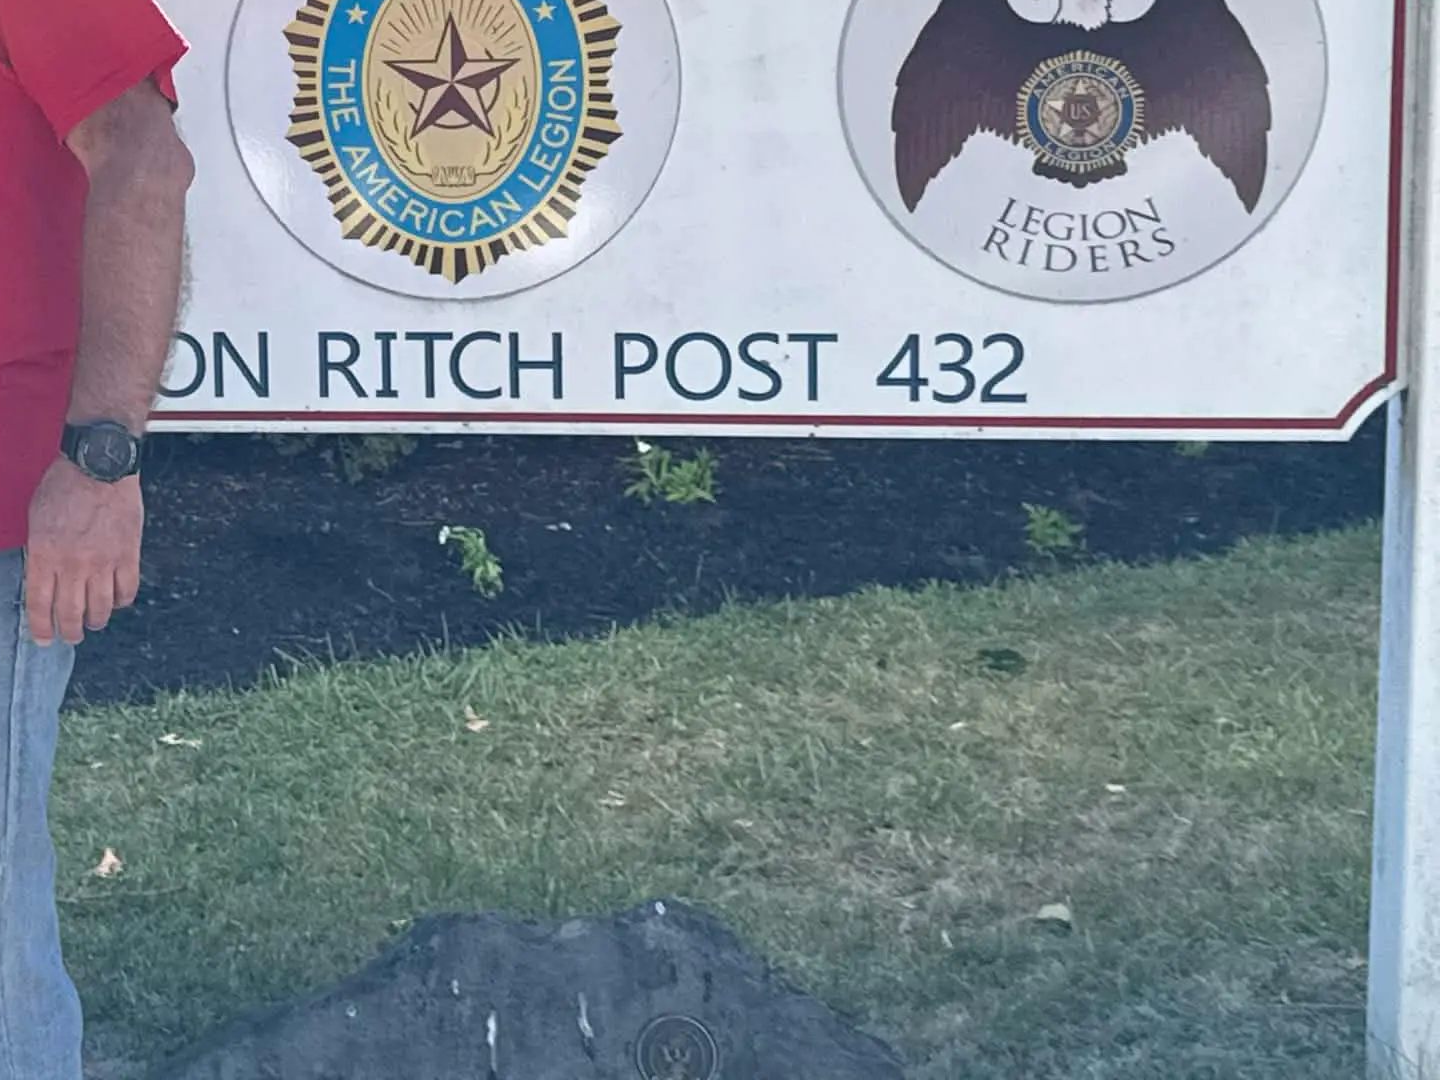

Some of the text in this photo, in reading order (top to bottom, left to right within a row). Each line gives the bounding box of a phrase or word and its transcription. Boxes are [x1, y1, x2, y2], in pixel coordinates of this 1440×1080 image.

[1032, 62, 1131, 100] AMERICAN
[327, 58, 577, 237] THE AMERICAN LEGION
[1044, 141, 1117, 161] LEGION
[996, 197, 1163, 242] LEGION
[980, 225, 1176, 273] RIDERS
[317, 331, 564, 400] RITCH
[614, 332, 840, 402] POST
[875, 333, 1030, 403] 432
